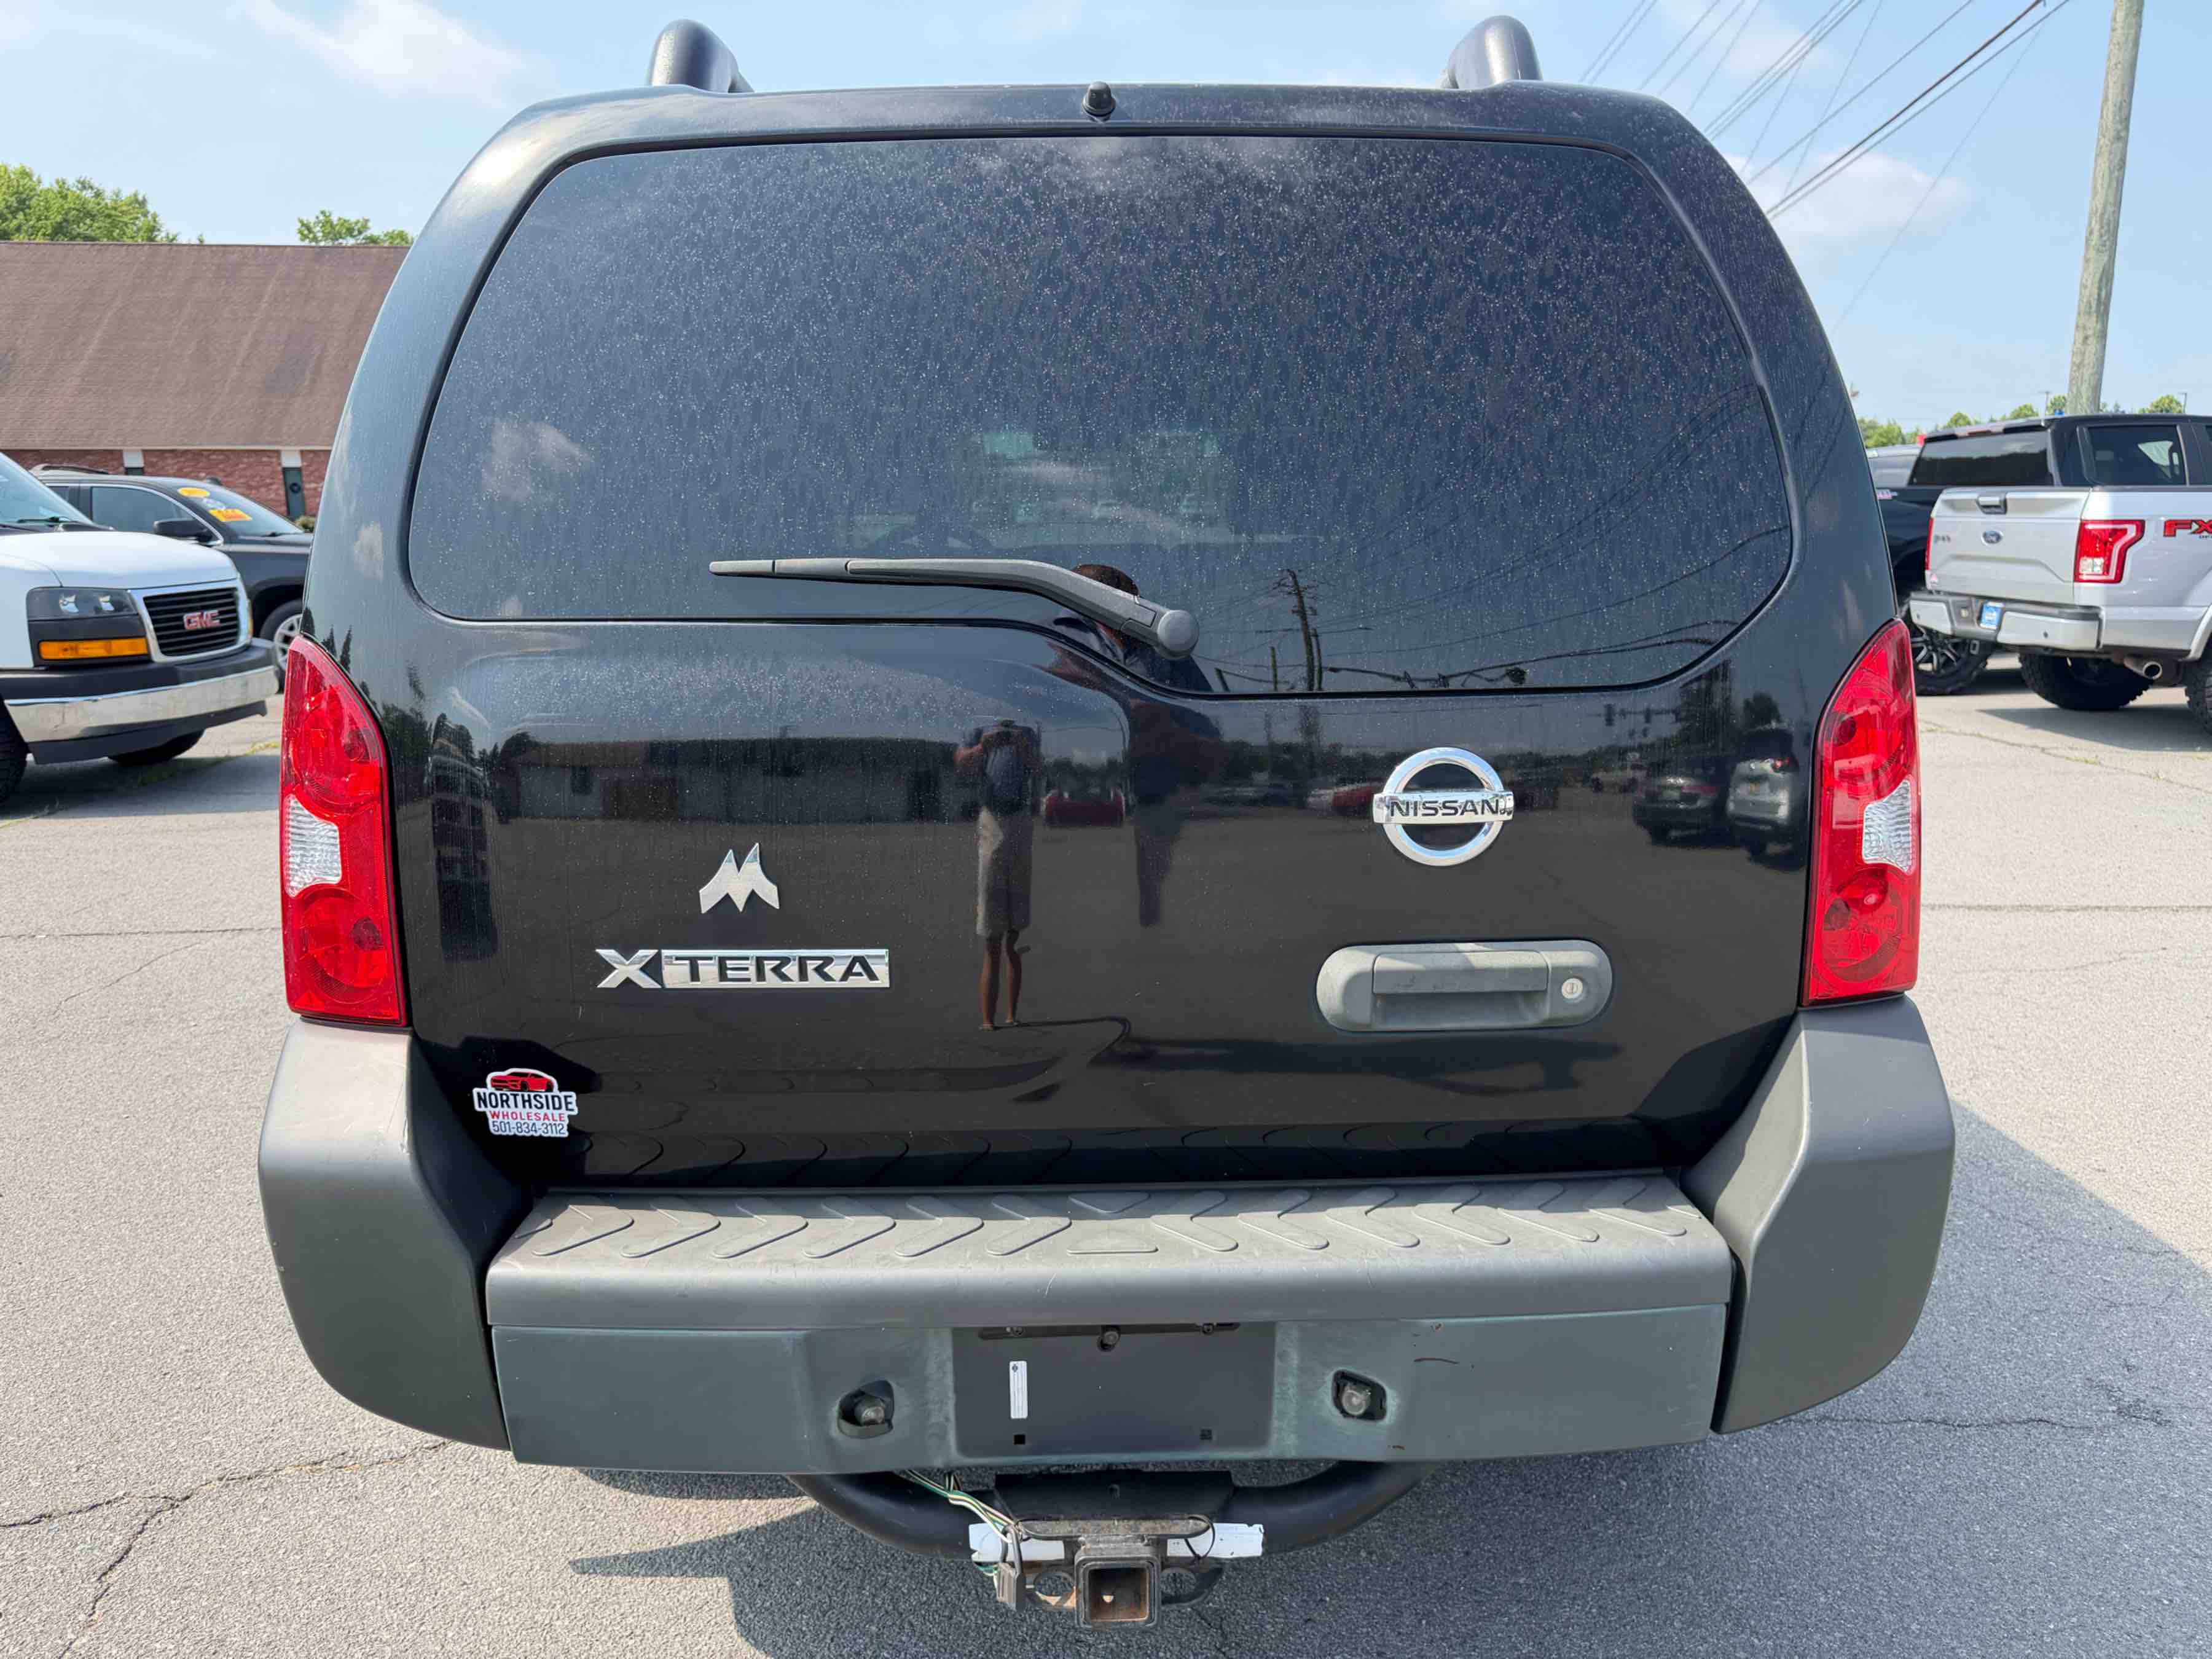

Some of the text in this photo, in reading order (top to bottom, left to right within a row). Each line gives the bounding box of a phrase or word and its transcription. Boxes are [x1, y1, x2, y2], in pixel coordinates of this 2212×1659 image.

[1390, 799, 1499, 817] NISSAN
[477, 1091, 575, 1112] NORTHSIDE
[490, 1111, 565, 1121] WHOLESALE
[492, 1121, 566, 1134] 501-834-3112
